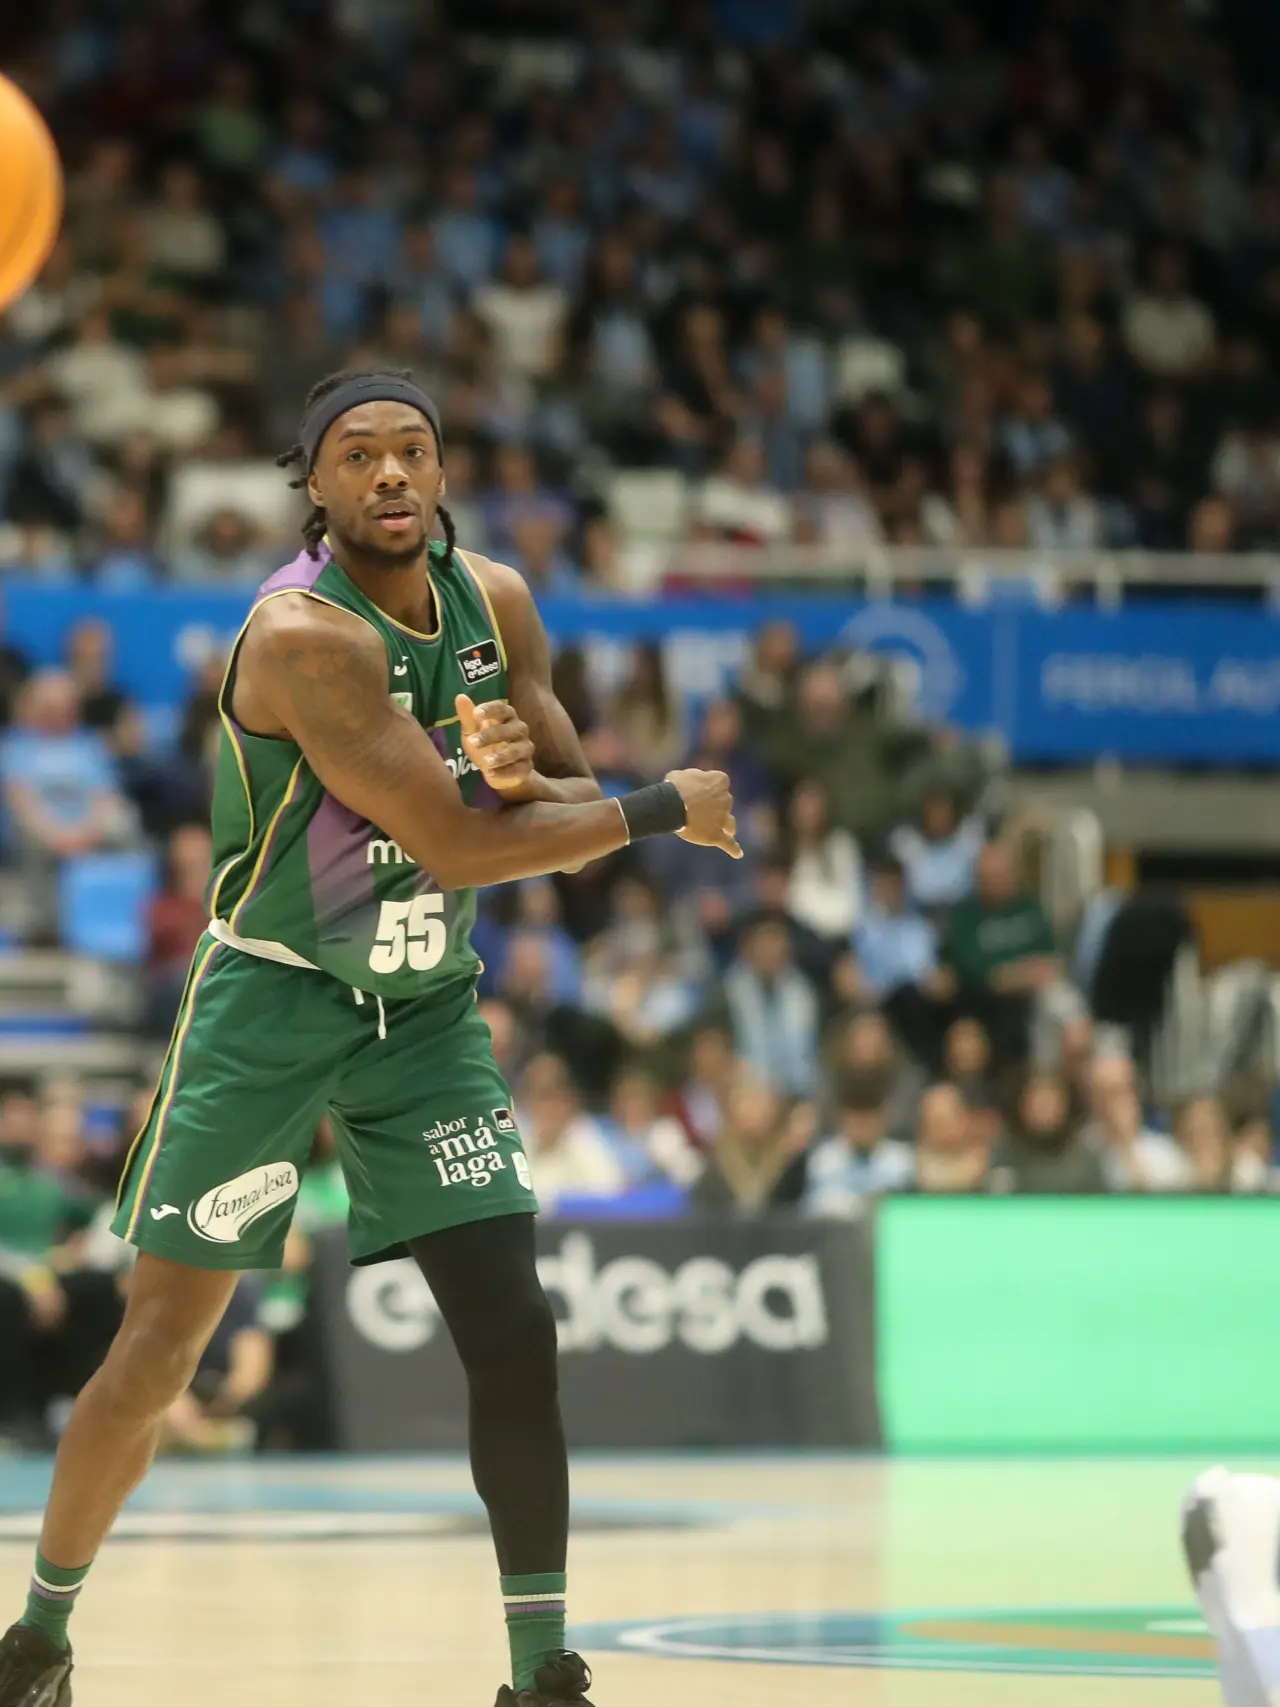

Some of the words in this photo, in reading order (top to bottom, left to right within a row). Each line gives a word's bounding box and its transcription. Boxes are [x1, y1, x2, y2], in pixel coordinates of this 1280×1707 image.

[467, 661, 499, 679] endesa
[368, 893, 447, 974] 55
[422, 1116, 467, 1141] sabor
[433, 1151, 507, 1187] laga
[346, 1232, 827, 1354] edesa
